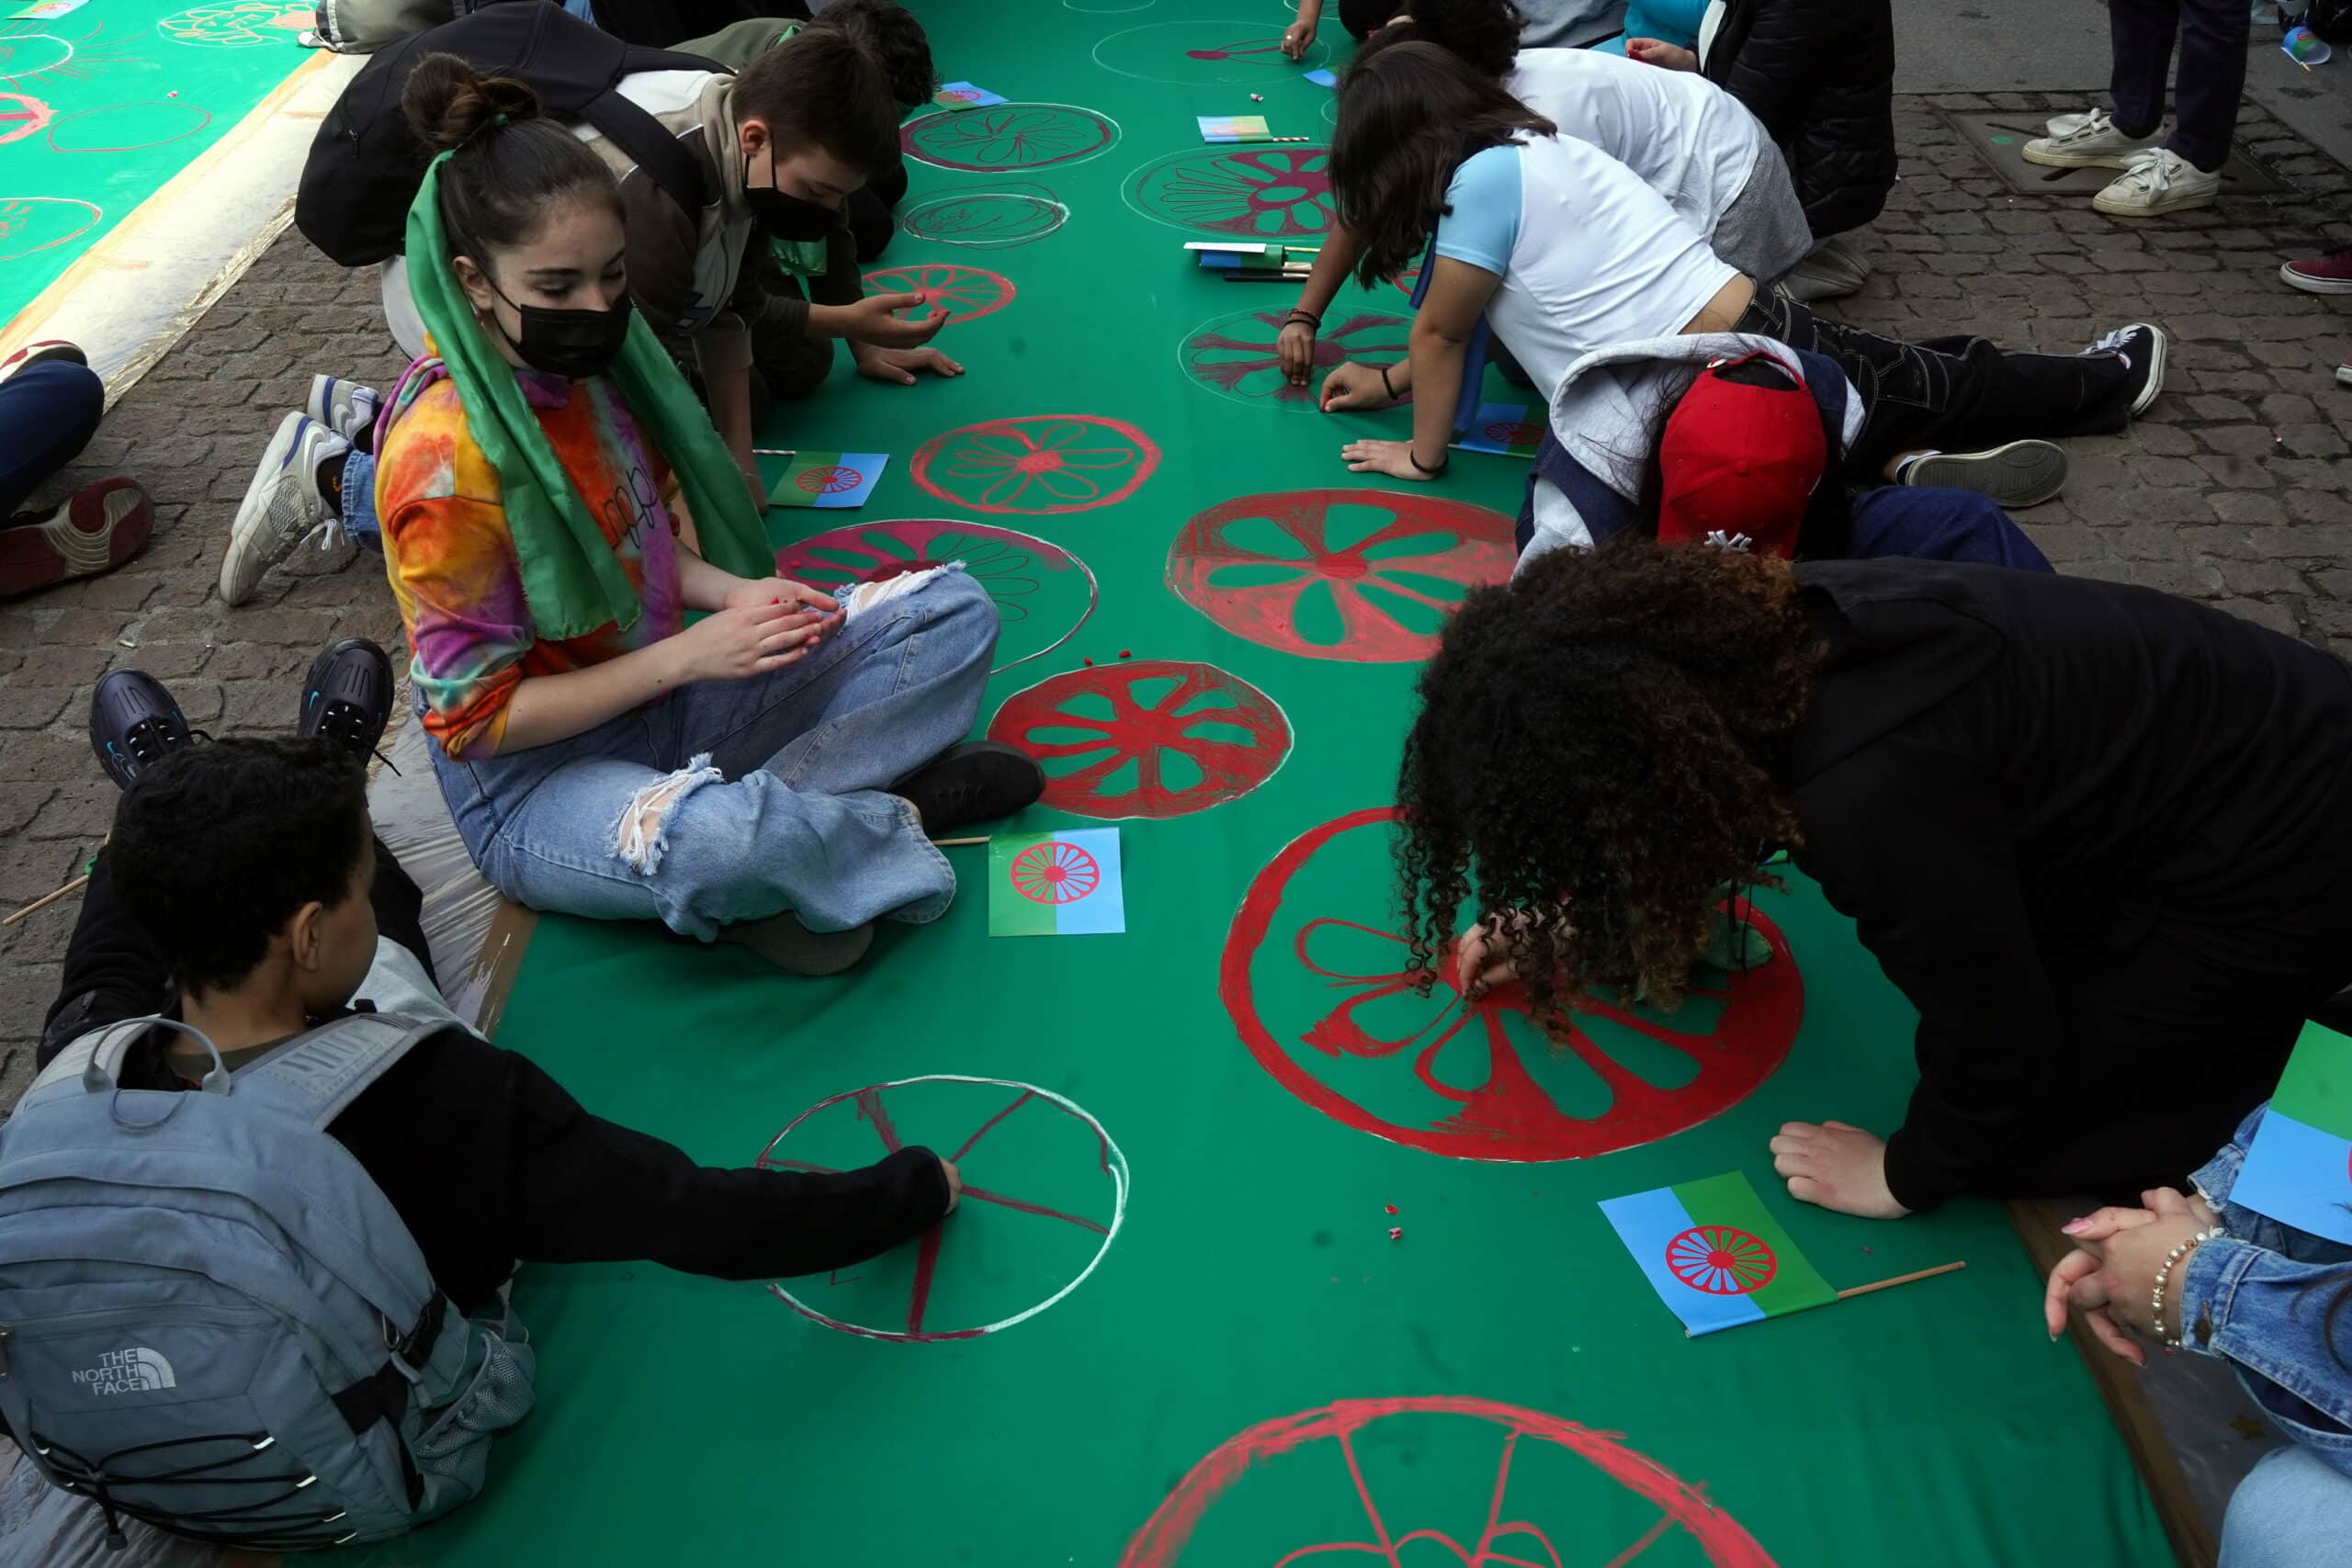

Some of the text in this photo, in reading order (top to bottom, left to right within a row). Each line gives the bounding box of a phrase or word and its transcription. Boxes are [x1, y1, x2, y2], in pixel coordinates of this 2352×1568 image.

[97, 1348, 137, 1367] THE
[72, 1364, 139, 1382] NORTH
[93, 1378, 141, 1394] FACE
